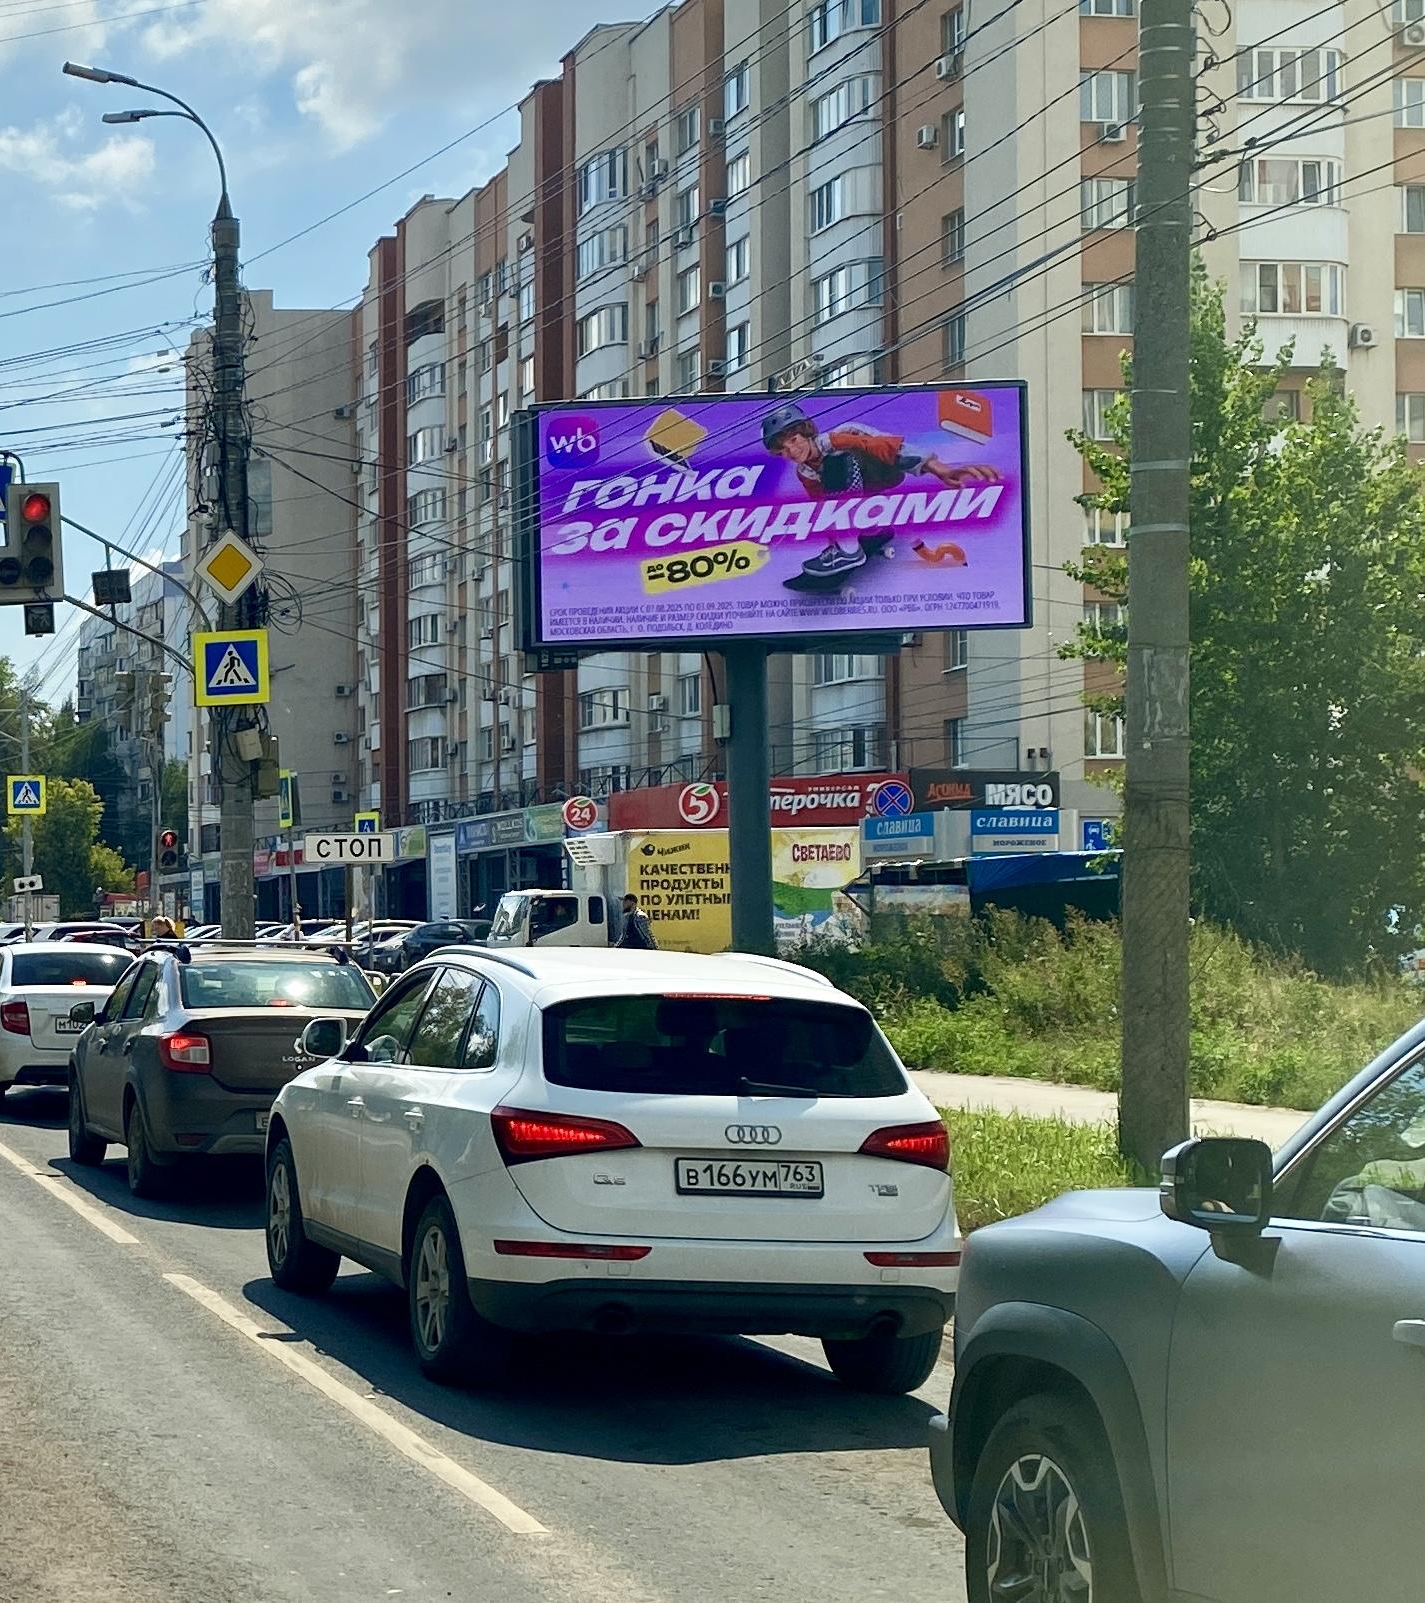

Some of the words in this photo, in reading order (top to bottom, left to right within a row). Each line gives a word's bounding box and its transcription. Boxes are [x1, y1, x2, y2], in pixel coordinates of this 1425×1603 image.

[549, 427, 597, 454] wb
[550, 517, 639, 555] за
[644, 485, 1004, 547] скидками
[985, 783, 1053, 806] МЯСО
[570, 807, 592, 821] 24
[316, 838, 381, 858] СТОП
[640, 878, 724, 892] ПРОДУКТЫ
[640, 894, 663, 906] ПО
[781, 1164, 816, 1182] 763
